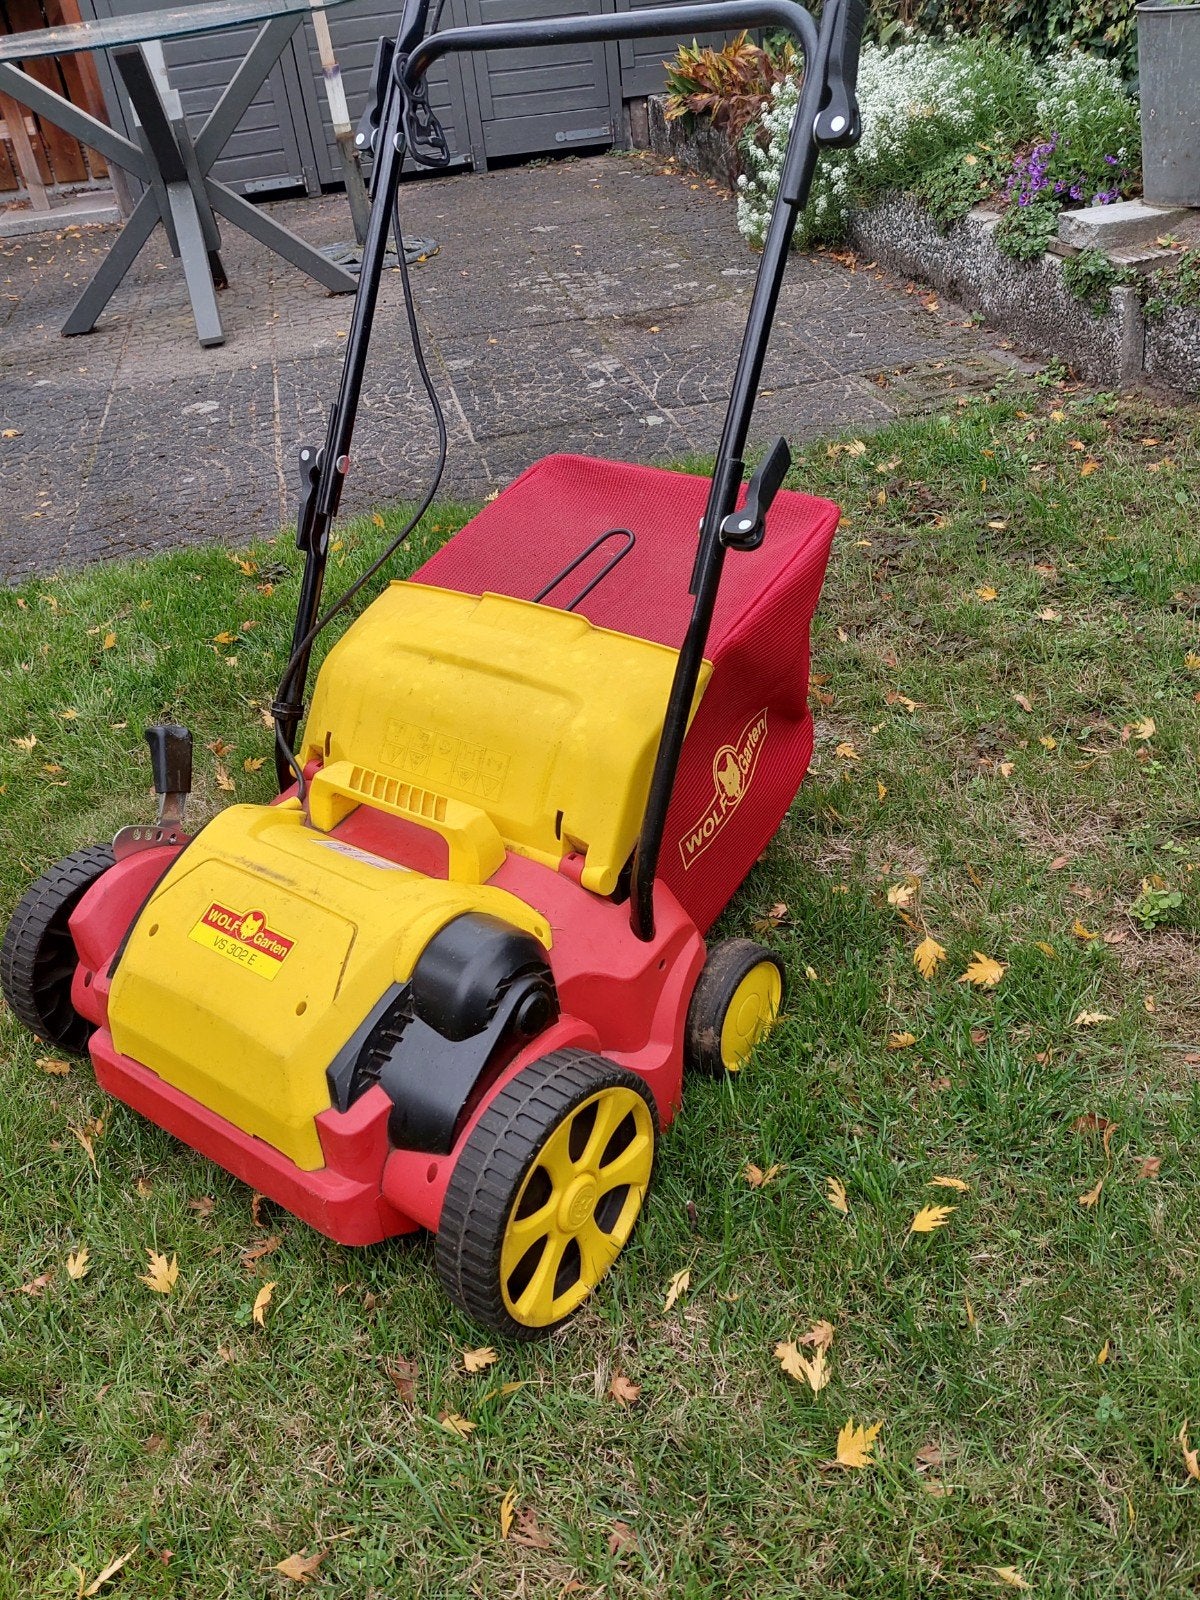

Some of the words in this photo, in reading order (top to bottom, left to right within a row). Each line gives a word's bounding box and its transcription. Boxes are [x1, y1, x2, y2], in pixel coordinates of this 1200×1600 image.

[685, 792, 727, 854] WOLF
[738, 718, 765, 775] Garten
[207, 908, 241, 932] WOLF
[253, 932, 288, 957] Garten
[213, 935, 228, 950] VS
[226, 943, 249, 961] 302
[247, 953, 258, 966] E
